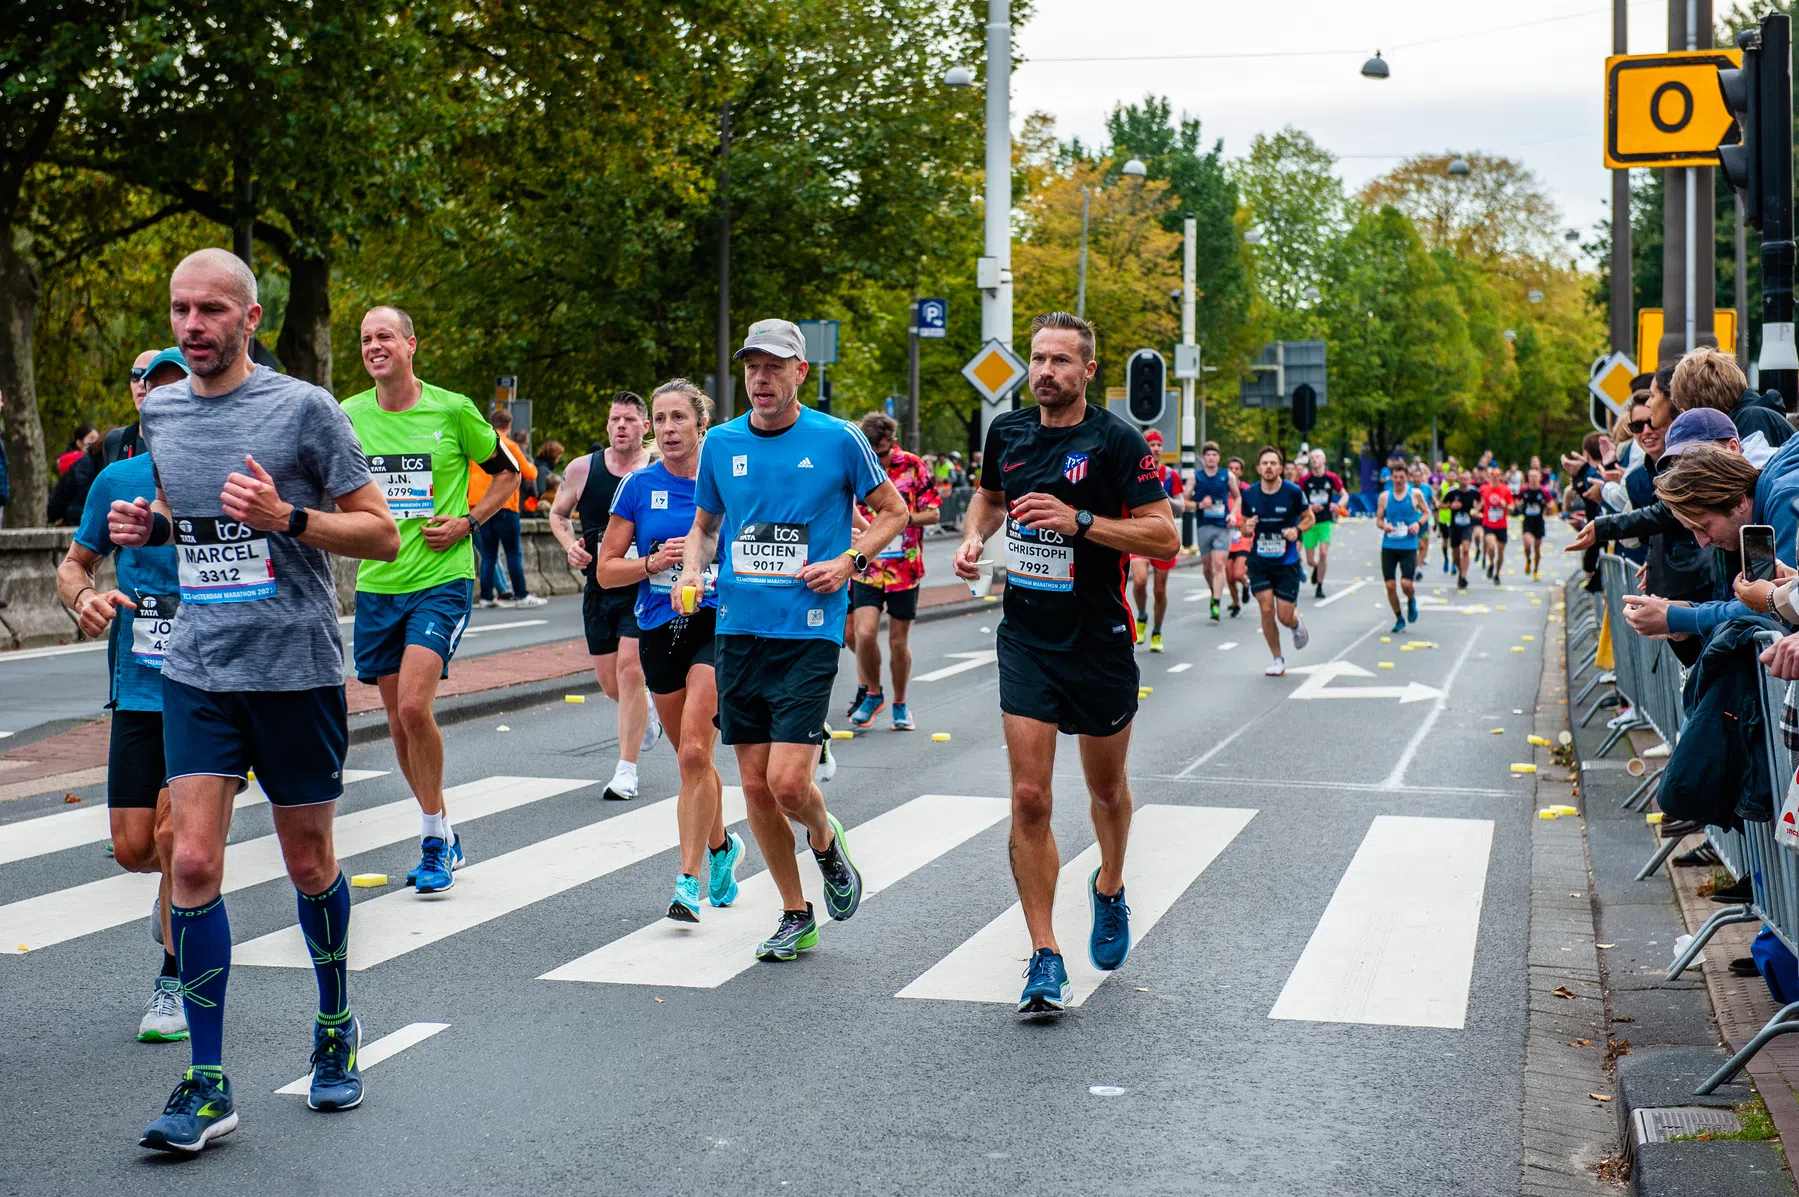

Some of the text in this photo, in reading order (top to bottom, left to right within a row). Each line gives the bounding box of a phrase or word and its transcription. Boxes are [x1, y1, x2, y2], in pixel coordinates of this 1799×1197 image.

[401, 456, 423, 470] tcs
[388, 474, 411, 484] J.N.
[387, 487, 412, 496] 6799
[215, 520, 252, 541] tcs
[774, 525, 799, 542] tcs
[1009, 529, 1022, 539] TATA
[1039, 528, 1064, 544] tcs
[180, 534, 197, 543] TATA
[184, 544, 260, 564] MARCEL
[743, 544, 796, 558] LUCIEN
[1008, 541, 1067, 559] CHRISTOPH
[753, 560, 784, 572] 9017
[1020, 560, 1049, 575] 7992
[199, 568, 240, 583] 3312
[223, 590, 257, 599] MARATHON
[140, 609, 159, 617] TATA
